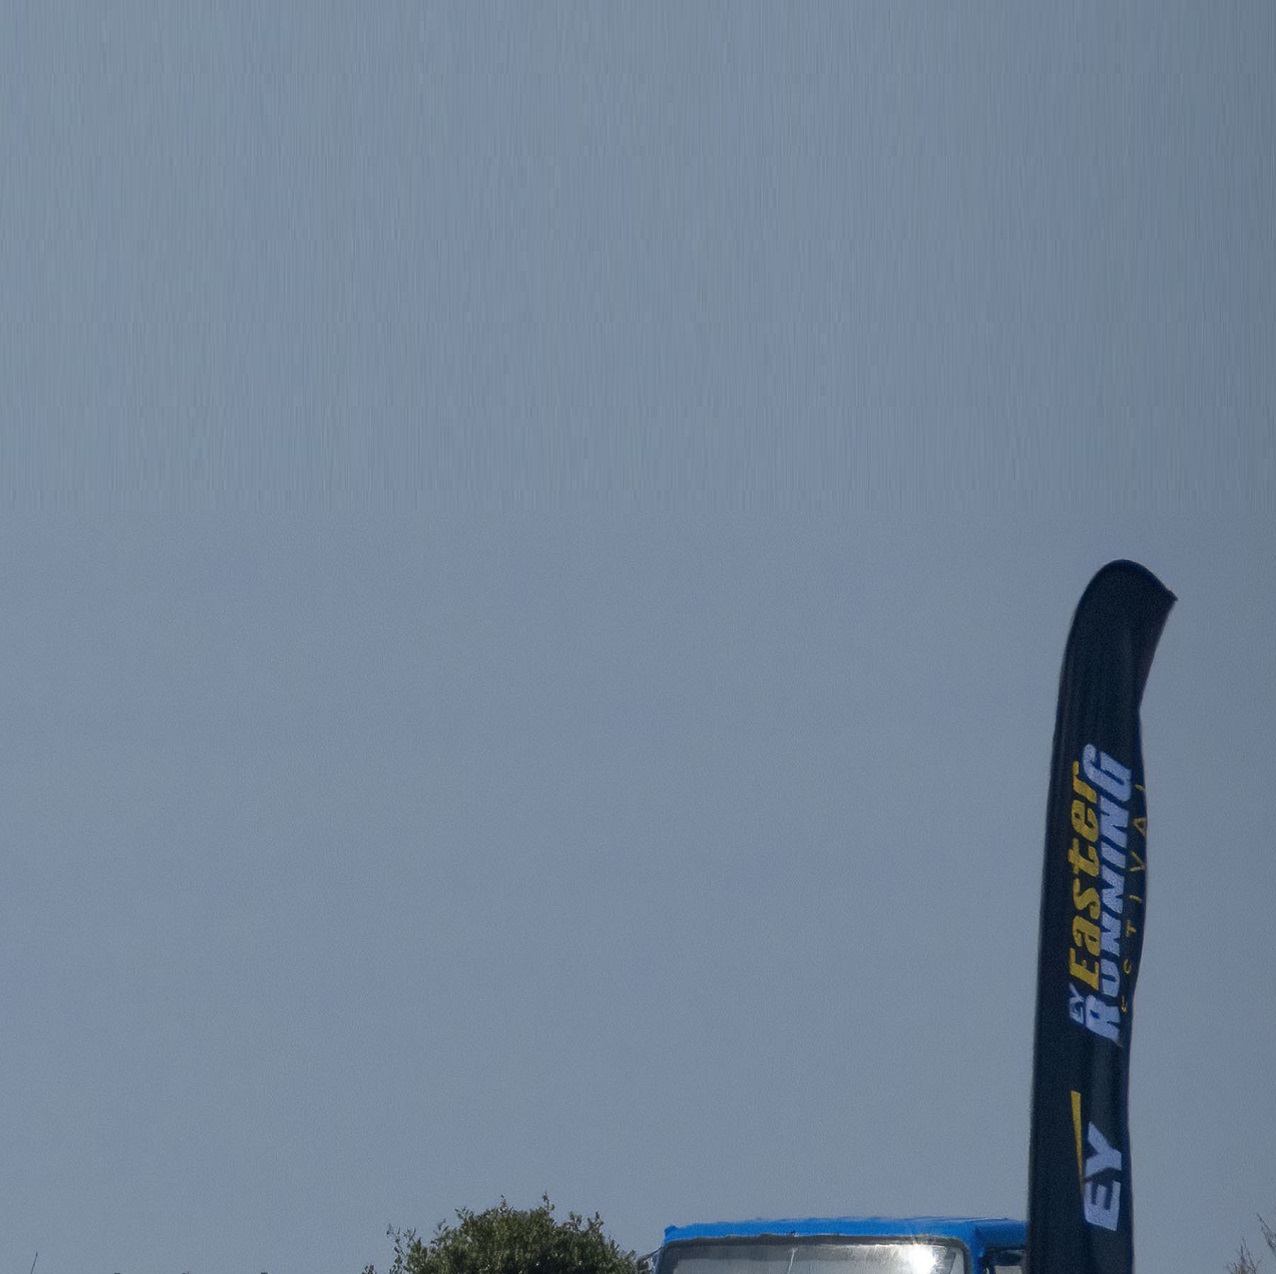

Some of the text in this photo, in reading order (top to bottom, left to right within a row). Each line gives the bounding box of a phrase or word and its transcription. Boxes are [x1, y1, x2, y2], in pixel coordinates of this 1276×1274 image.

[1068, 760, 1100, 991] Easter
[1082, 743, 1132, 1042] RUNNING
[1083, 1120, 1123, 1232] EY
